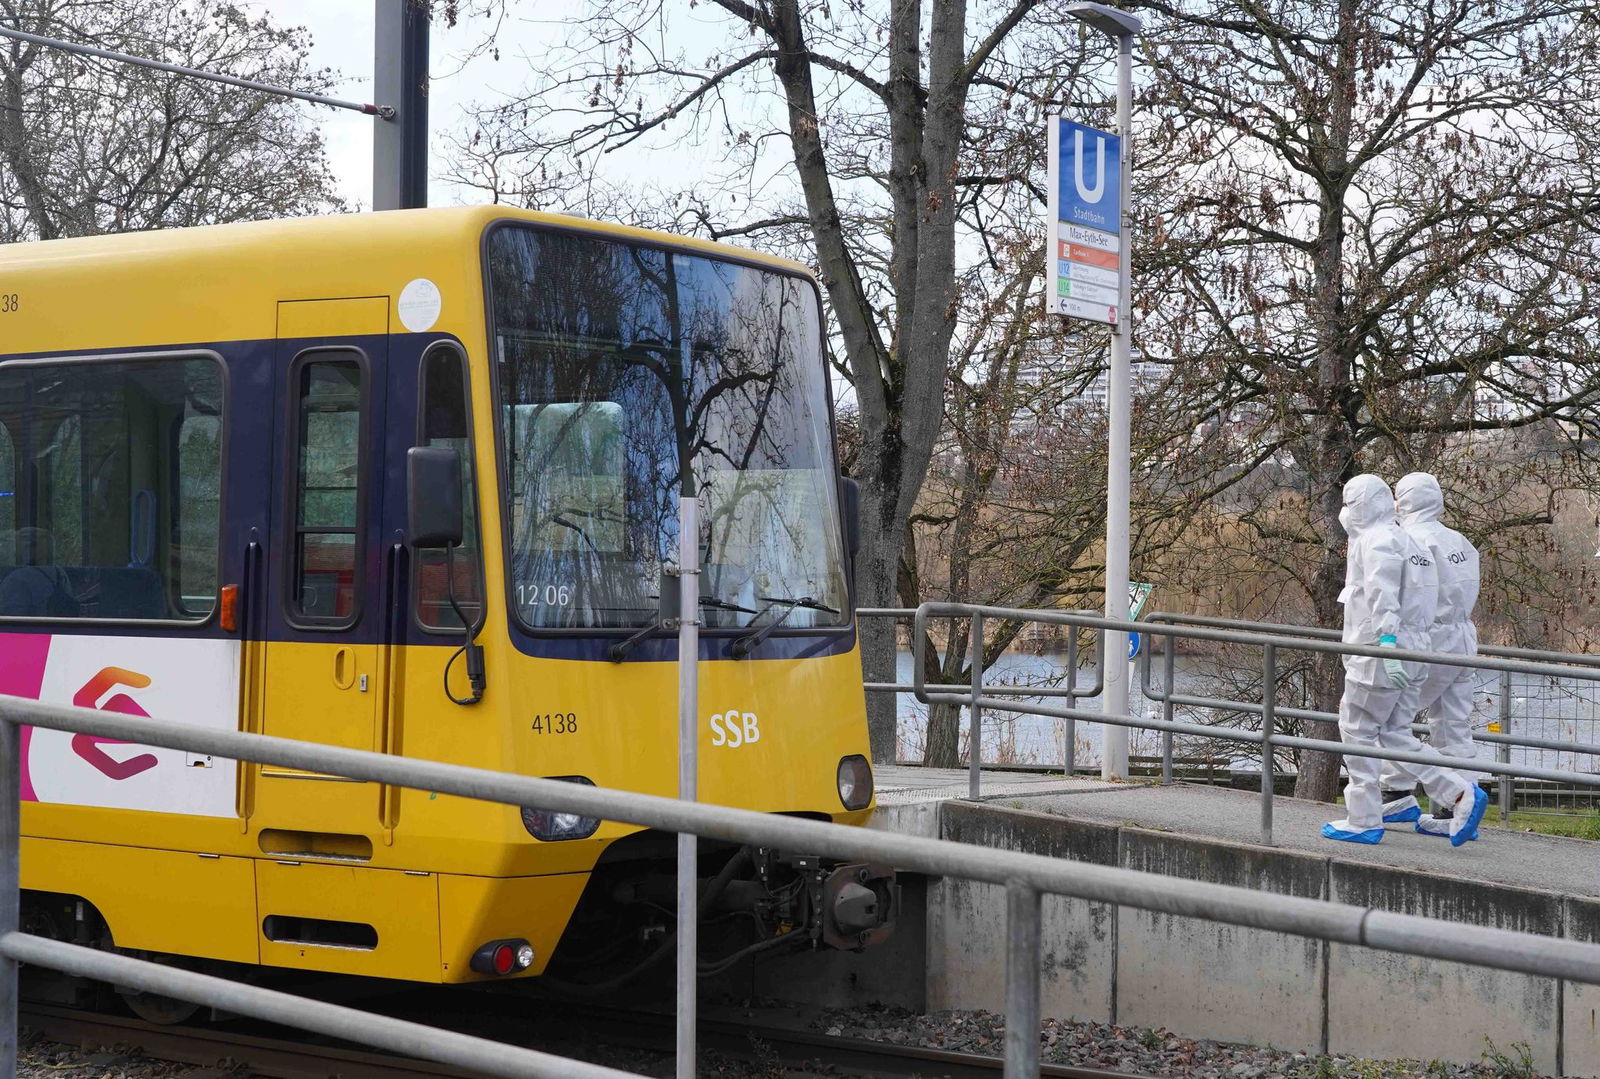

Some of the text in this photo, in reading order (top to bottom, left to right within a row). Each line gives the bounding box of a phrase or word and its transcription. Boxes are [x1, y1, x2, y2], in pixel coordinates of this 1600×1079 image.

[1074, 129, 1105, 204] U
[1073, 206, 1105, 224] Stadtbahn
[1069, 227, 1108, 247] Max-Eyth-See
[1058, 262, 1070, 275] U12
[1, 293, 19, 313] 38
[518, 584, 569, 606] 12 06
[531, 712, 578, 735] 4138
[709, 709, 760, 748] SSB
